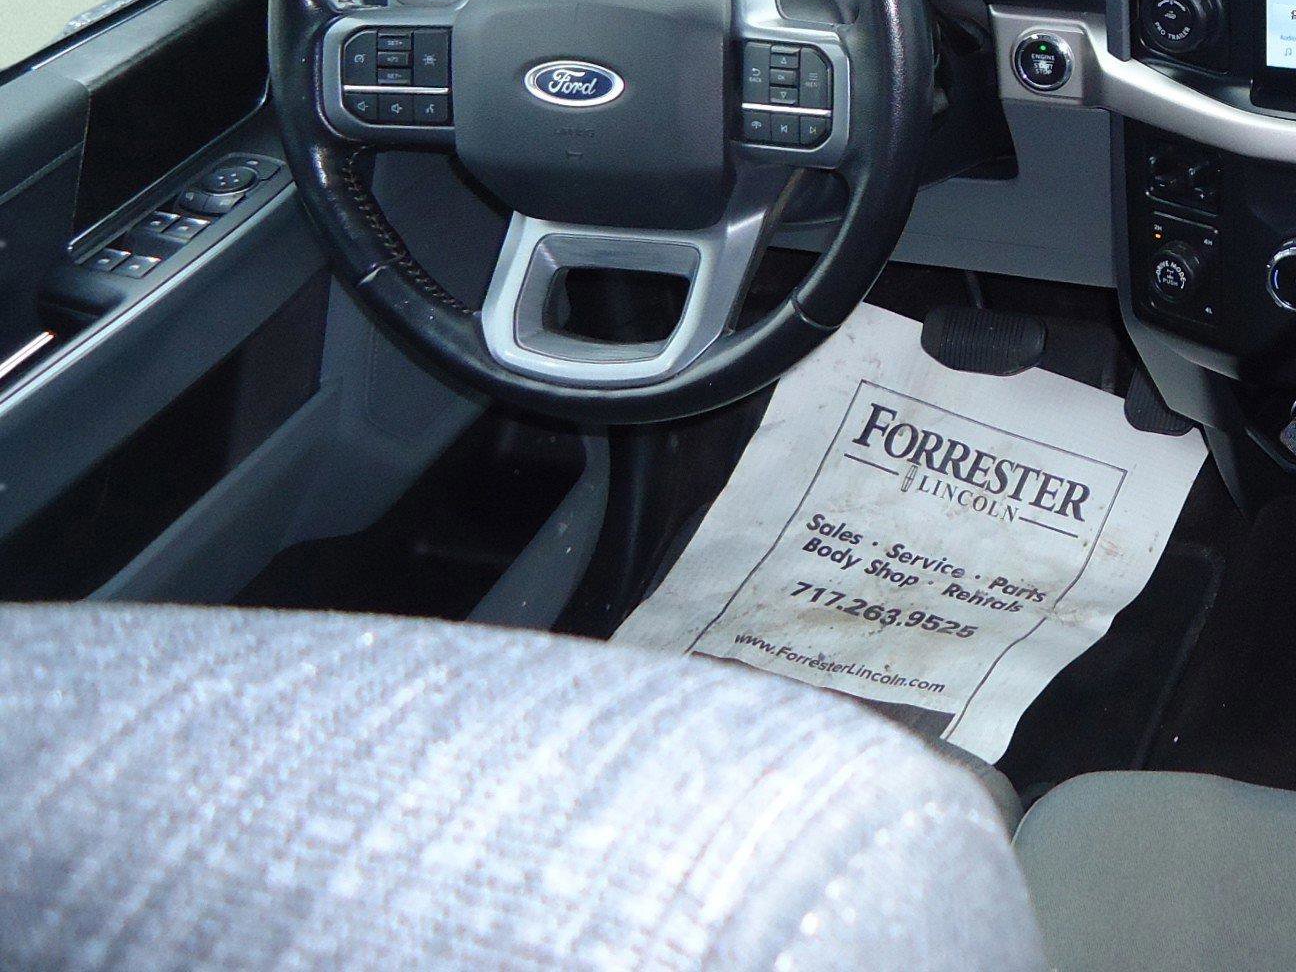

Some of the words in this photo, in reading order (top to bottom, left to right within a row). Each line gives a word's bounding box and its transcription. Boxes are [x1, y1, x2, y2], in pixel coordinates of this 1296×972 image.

[1154, 22, 1166, 35] PRO
[1168, 26, 1190, 40] TRAILER
[548, 68, 598, 95] Ford
[1203, 238, 1213, 246] 4H
[1156, 260, 1170, 275] DRIVE
[1170, 261, 1187, 282] MODE
[1162, 277, 1178, 287] PUSH
[852, 402, 1090, 522] FORRESTER
[916, 474, 1020, 524] LINCOLN
[802, 536, 862, 571] Body
[864, 558, 920, 588] Shop
[941, 582, 1024, 613] Rentals
[806, 513, 864, 546] Sales
[885, 542, 966, 579] Service
[987, 576, 1047, 604] Parts
[790, 581, 979, 639] 717.263.9525
[734, 633, 946, 694] www.ForresterLincoln.com
